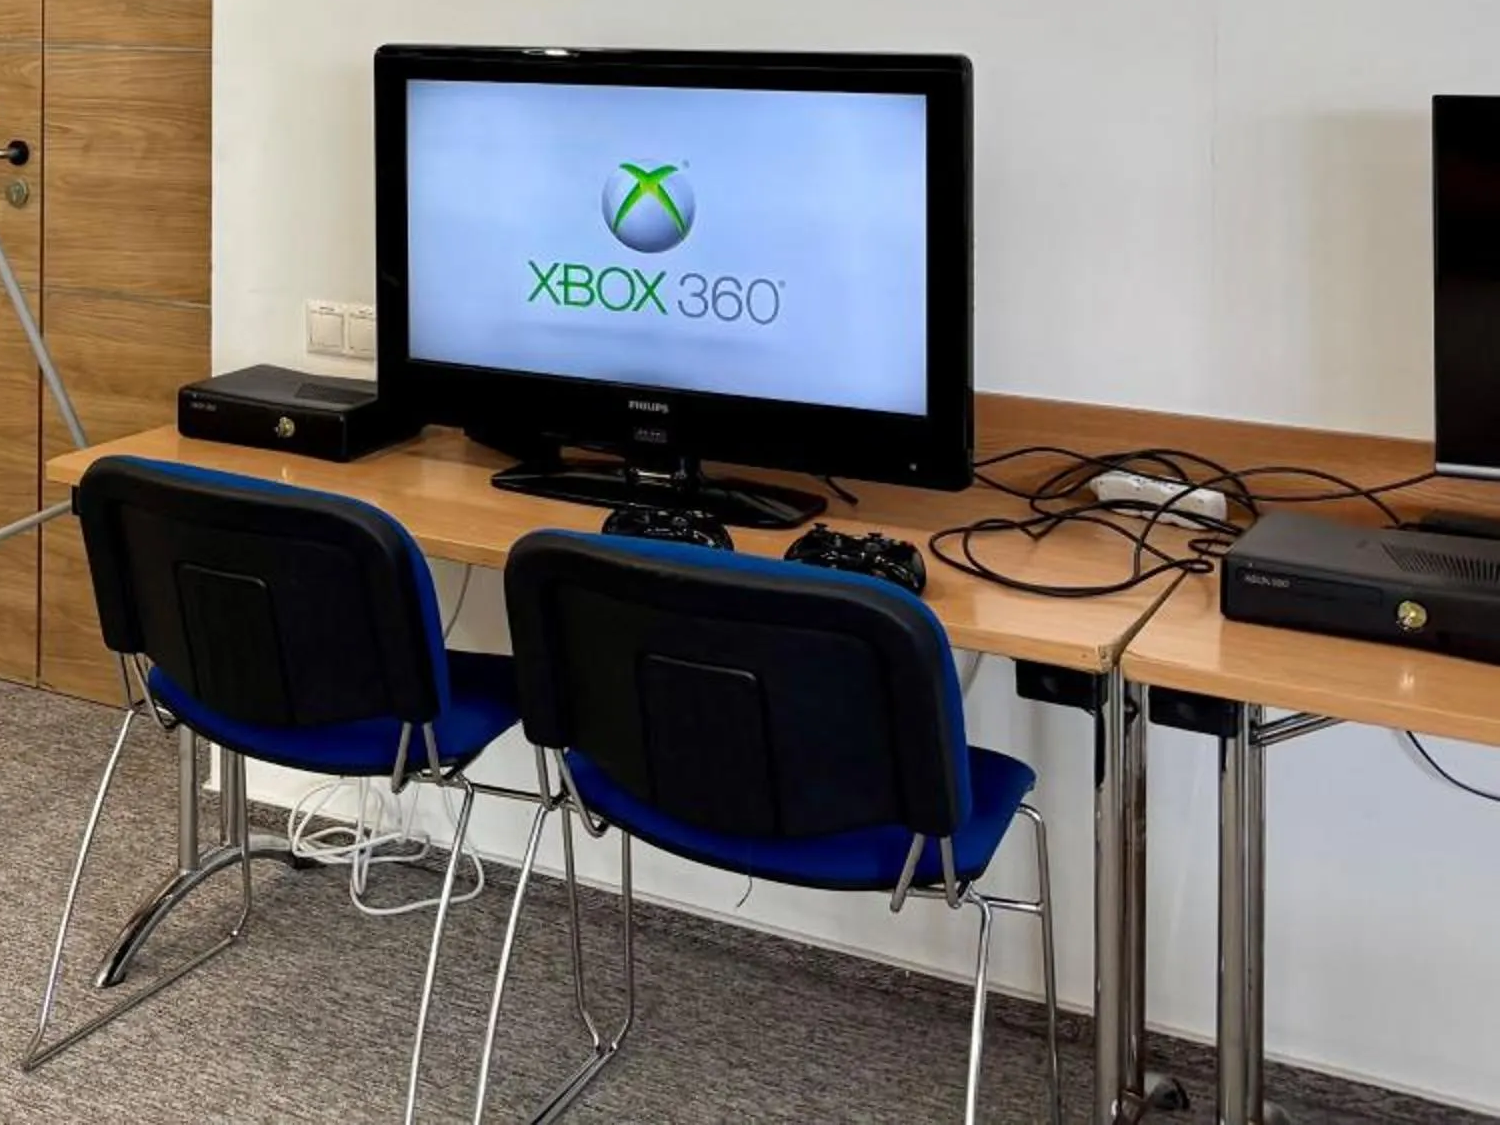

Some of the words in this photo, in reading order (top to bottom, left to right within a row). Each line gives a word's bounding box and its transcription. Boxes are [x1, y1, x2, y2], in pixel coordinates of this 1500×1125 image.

[528, 260, 668, 315] XBOX
[678, 273, 780, 325] 360
[628, 400, 669, 414] PHILIPS
